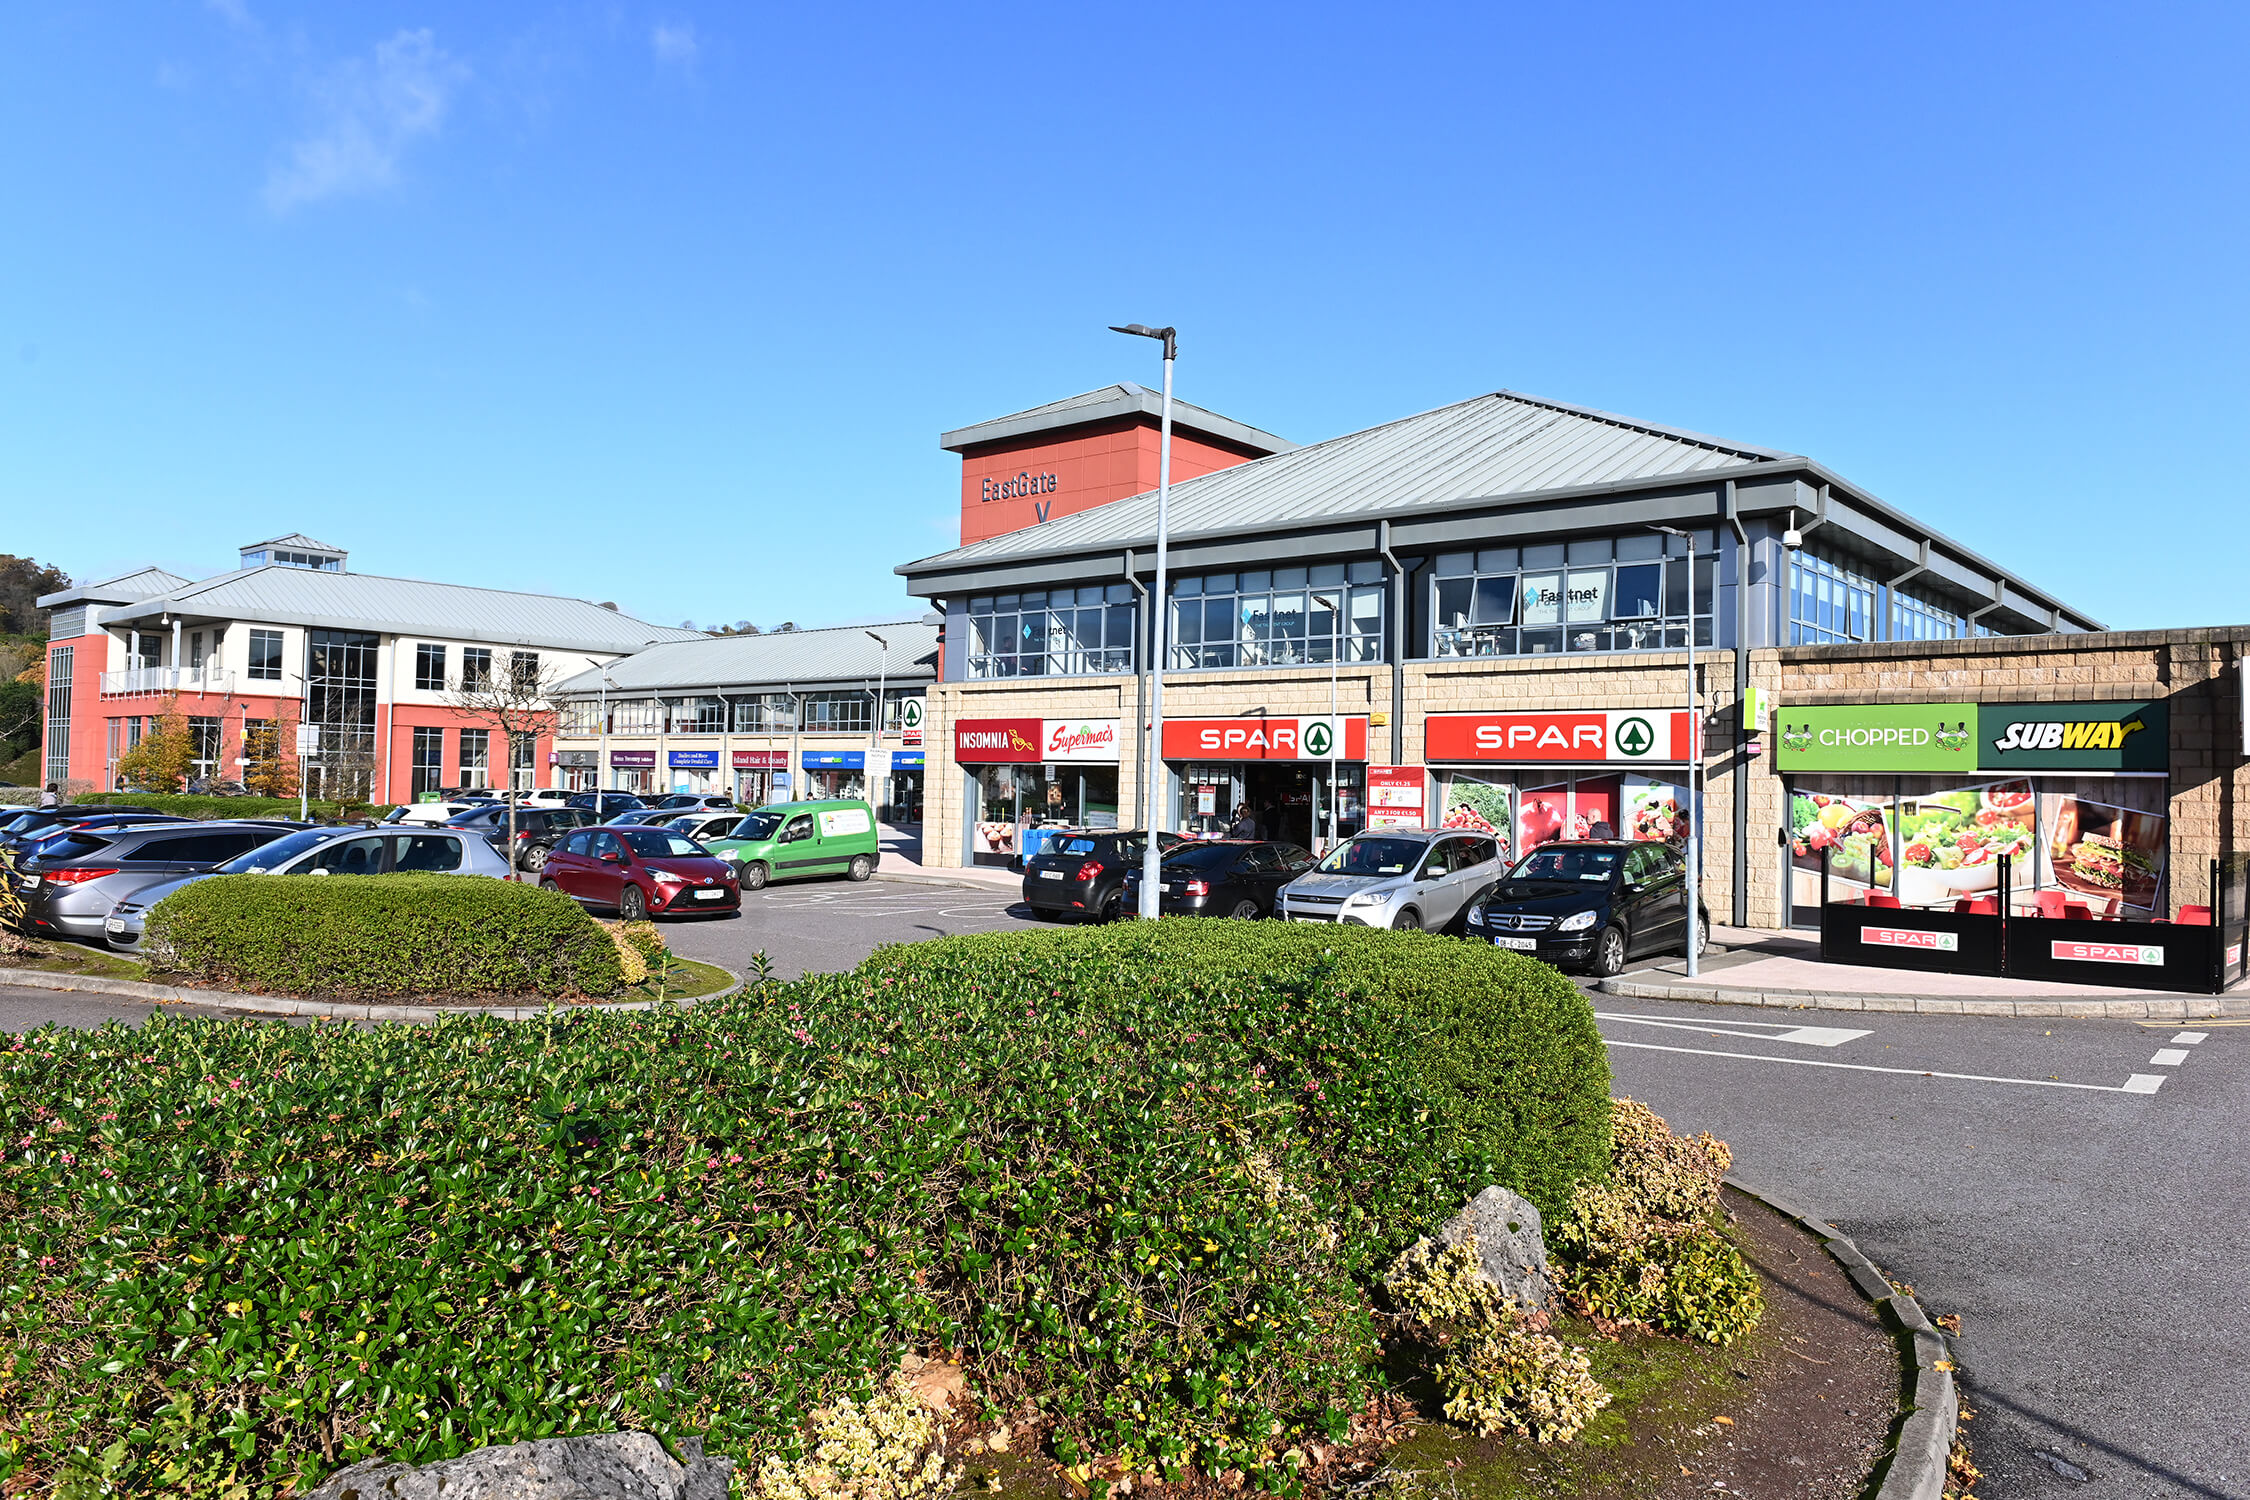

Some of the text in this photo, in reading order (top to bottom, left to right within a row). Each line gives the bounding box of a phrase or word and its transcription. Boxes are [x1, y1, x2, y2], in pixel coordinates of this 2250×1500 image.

[982, 472, 1058, 502] EastGate
[1035, 501, 1051, 523] V
[1540, 587, 1598, 602] Fastnet
[959, 732, 1009, 749] INSOMNIA
[1048, 724, 1114, 755] Supermac's
[1200, 729, 1296, 750] SPAR
[1476, 725, 1603, 749] SPAR
[1819, 728, 1930, 746] CHOPPED
[1993, 718, 2146, 753] SUBWAY
[734, 756, 749, 764] Island
[749, 756, 761, 764] Hair
[762, 756, 767, 764] &
[1879, 931, 1936, 945] SPAR
[2073, 946, 2139, 960] SPAR
